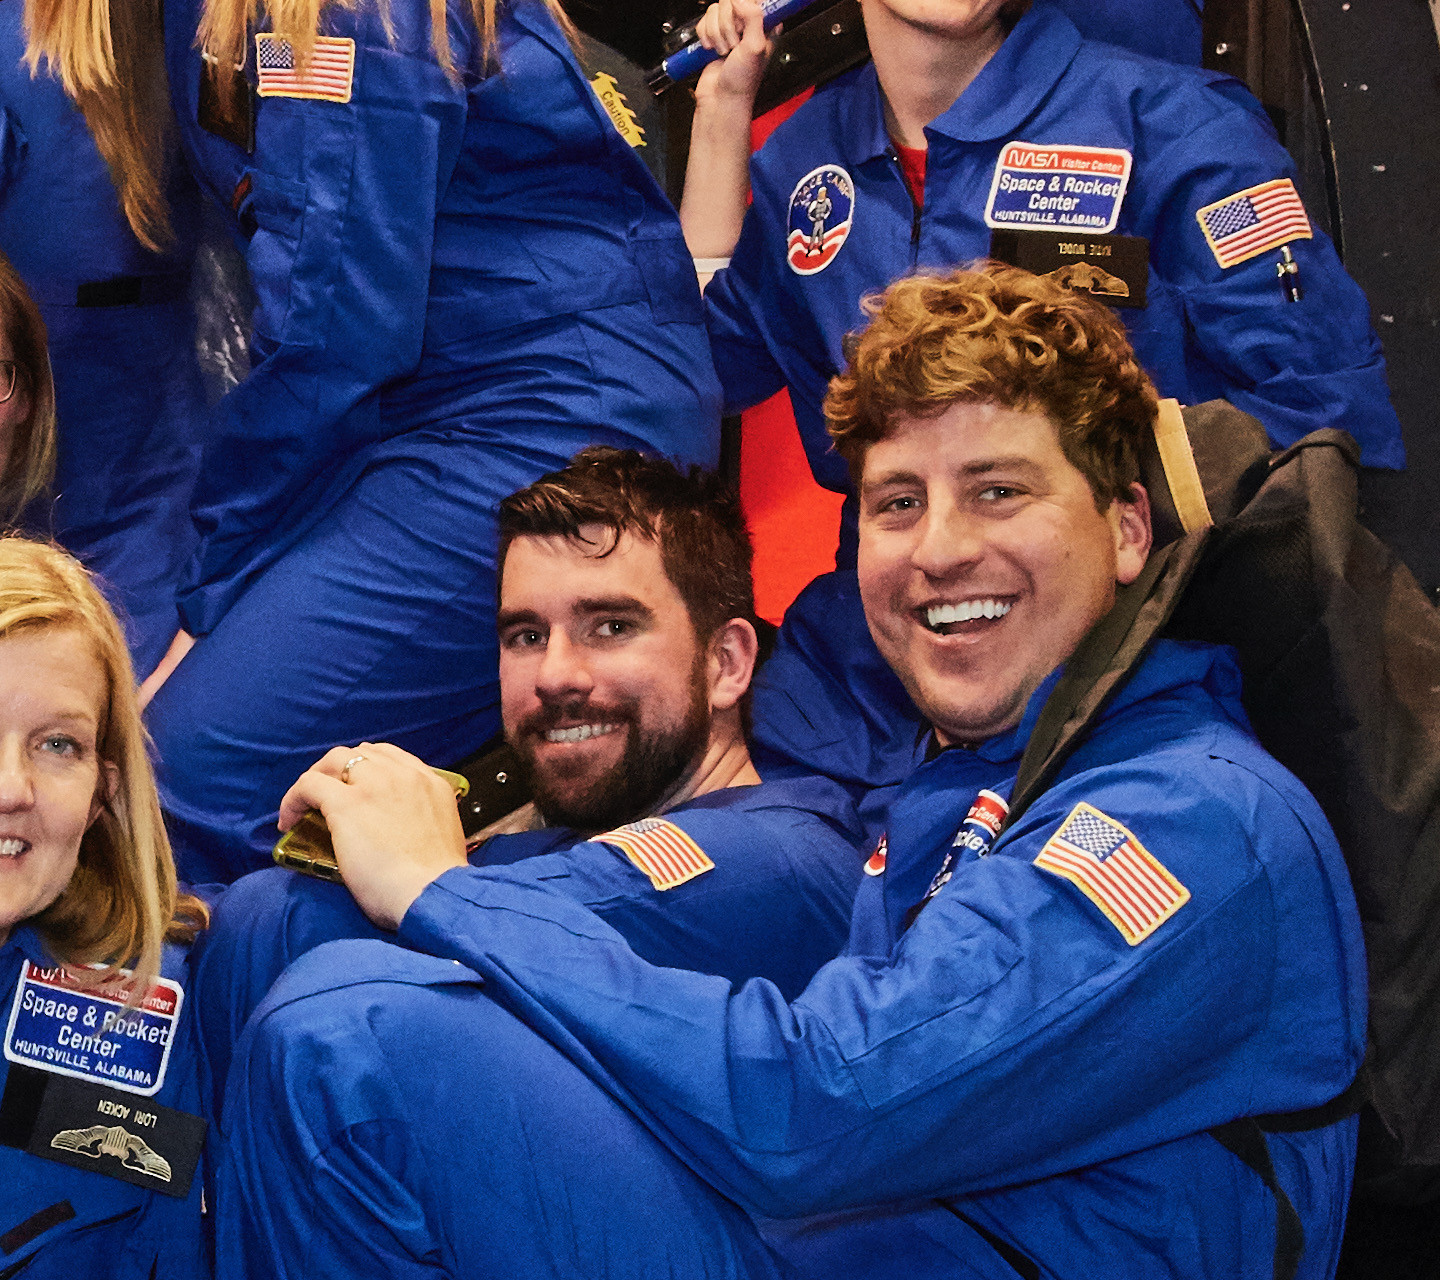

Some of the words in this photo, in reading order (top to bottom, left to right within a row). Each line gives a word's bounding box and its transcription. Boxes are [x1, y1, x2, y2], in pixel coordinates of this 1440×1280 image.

[601, 90, 630, 137] Caution
[1008, 149, 1059, 168] NASA
[1062, 158, 1090, 169] Visitor
[1091, 160, 1122, 172] Center
[1000, 173, 1046, 194] Space
[1048, 175, 1061, 193] &
[1063, 177, 1120, 198] Rocket
[1028, 193, 1080, 211] Center
[994, 210, 1057, 224] HUNTSVILLE,
[1059, 213, 1107, 227] ALABAMA
[975, 806, 1002, 831] Cente
[143, 996, 174, 1012] enter
[22, 989, 78, 1022] Space
[82, 1005, 98, 1028] &
[104, 1010, 170, 1047] Rocket
[57, 1025, 122, 1060] Center
[15, 1039, 91, 1071] HUNTSVILLE,
[94, 1060, 151, 1085] ALABAMA
[96, 1099, 131, 1120] ACKEN
[133, 1110, 158, 1129] LORI
